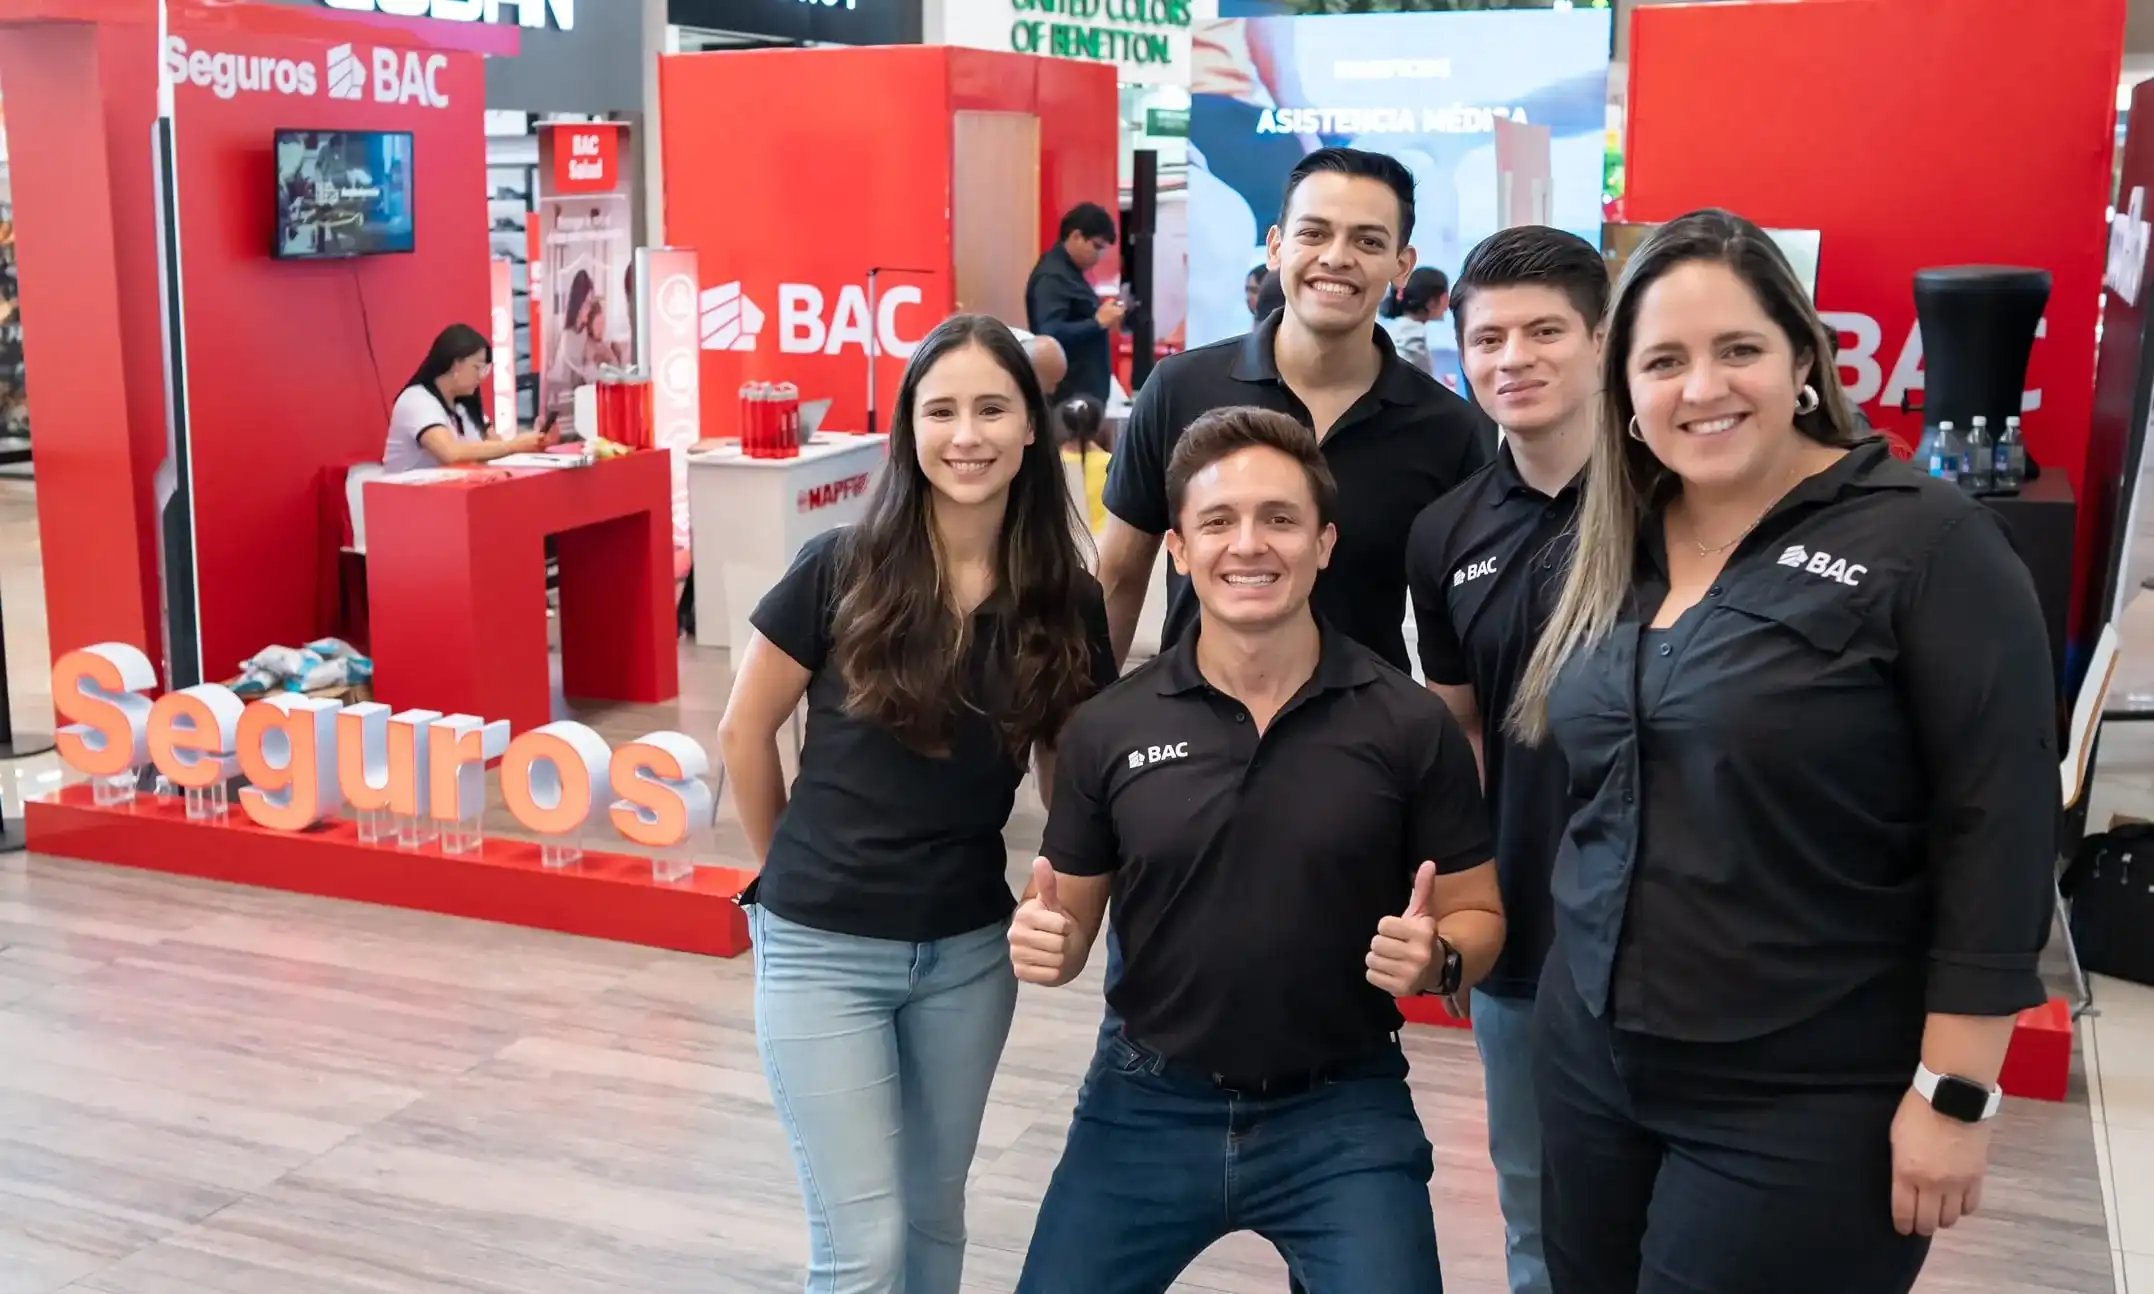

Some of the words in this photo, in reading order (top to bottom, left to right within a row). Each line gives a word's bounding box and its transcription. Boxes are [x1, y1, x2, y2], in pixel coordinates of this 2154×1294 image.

[1011, 20, 1046, 53] OF
[166, 35, 317, 99] Seguros
[372, 46, 449, 109] BAC
[1256, 106, 1416, 134] ASISTENCIA
[778, 283, 922, 359] BAC
[1816, 311, 2048, 413] BA
[808, 472, 869, 511] MAPF
[1467, 556, 1497, 581] BAC
[1805, 551, 1868, 587] BAC
[51, 642, 714, 847] Seguros
[1147, 741, 1188, 763] BAC
